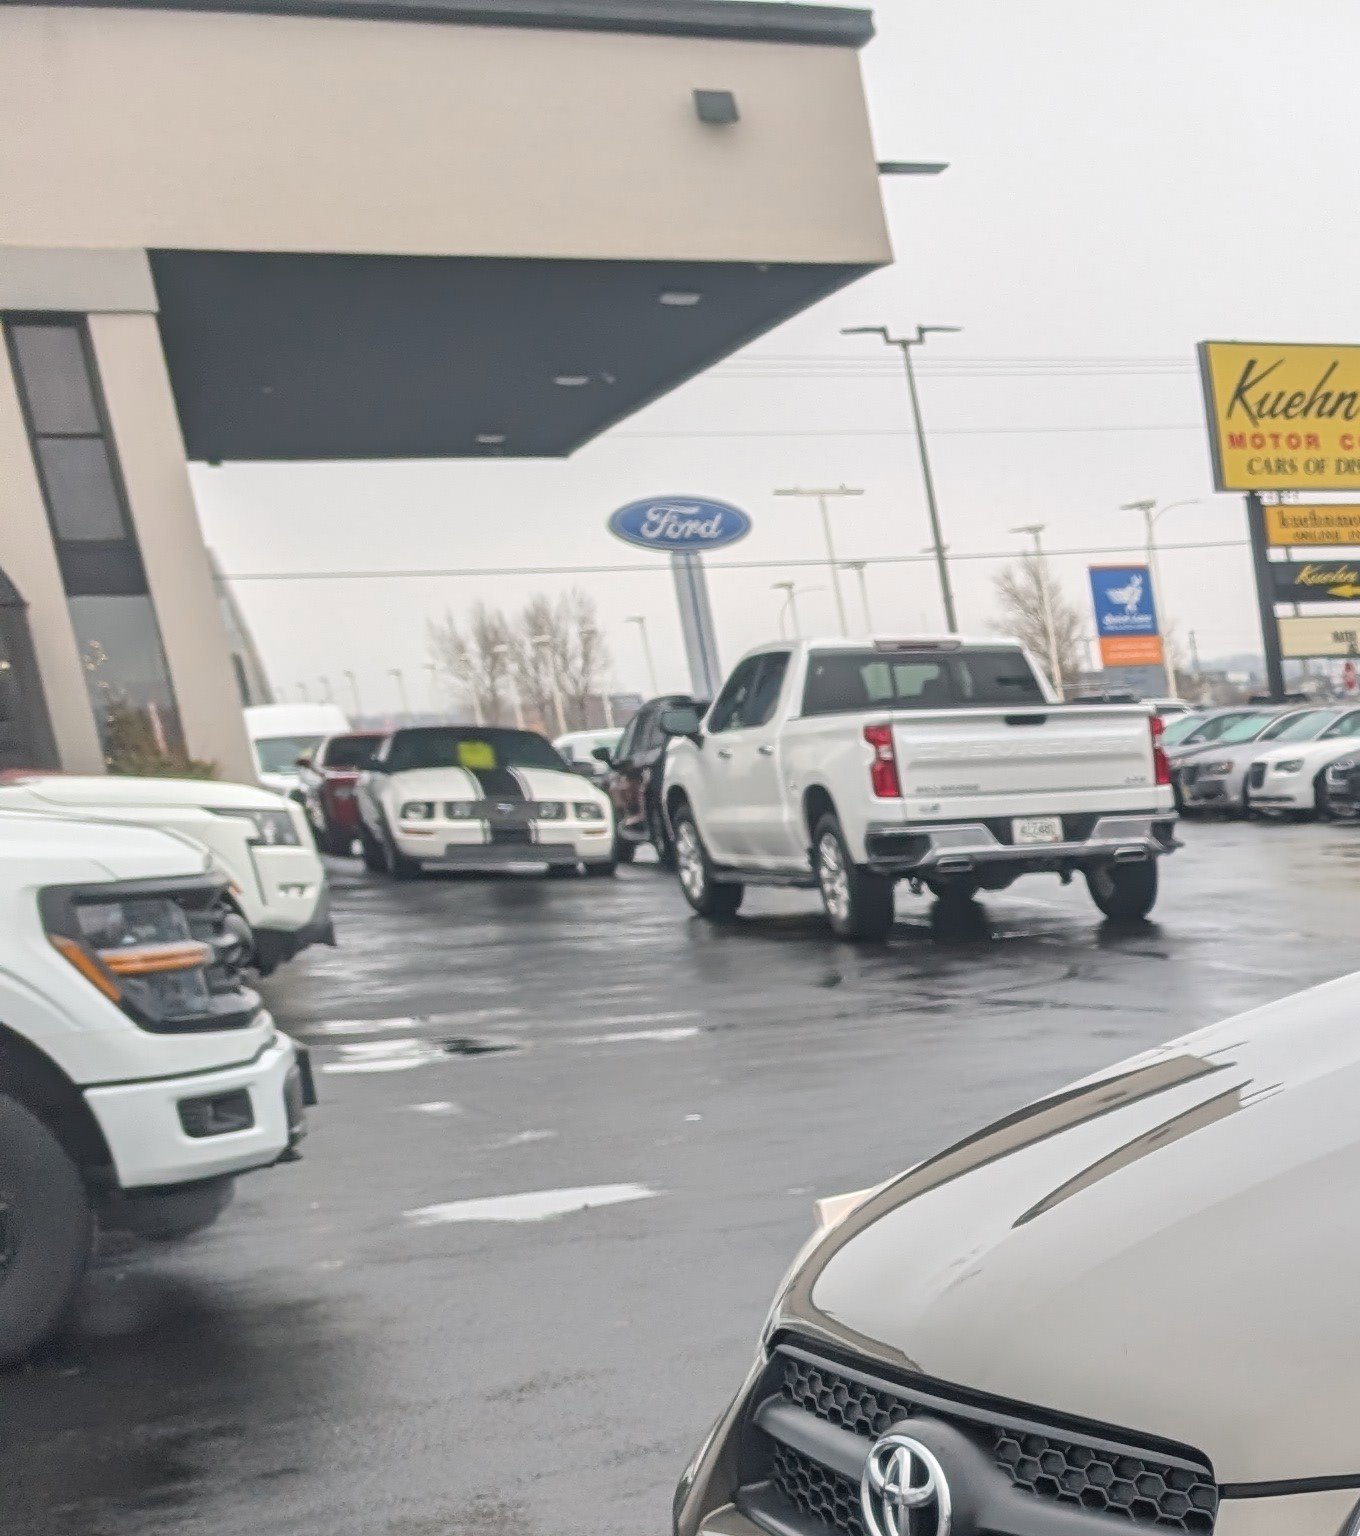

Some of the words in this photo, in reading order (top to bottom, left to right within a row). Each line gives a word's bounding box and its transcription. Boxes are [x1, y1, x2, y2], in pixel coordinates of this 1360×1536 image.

[1228, 432, 1321, 451] MOTOR
[1247, 456, 1298, 476] CARS
[1303, 457, 1328, 475] OF
[640, 504, 723, 539] Ford
